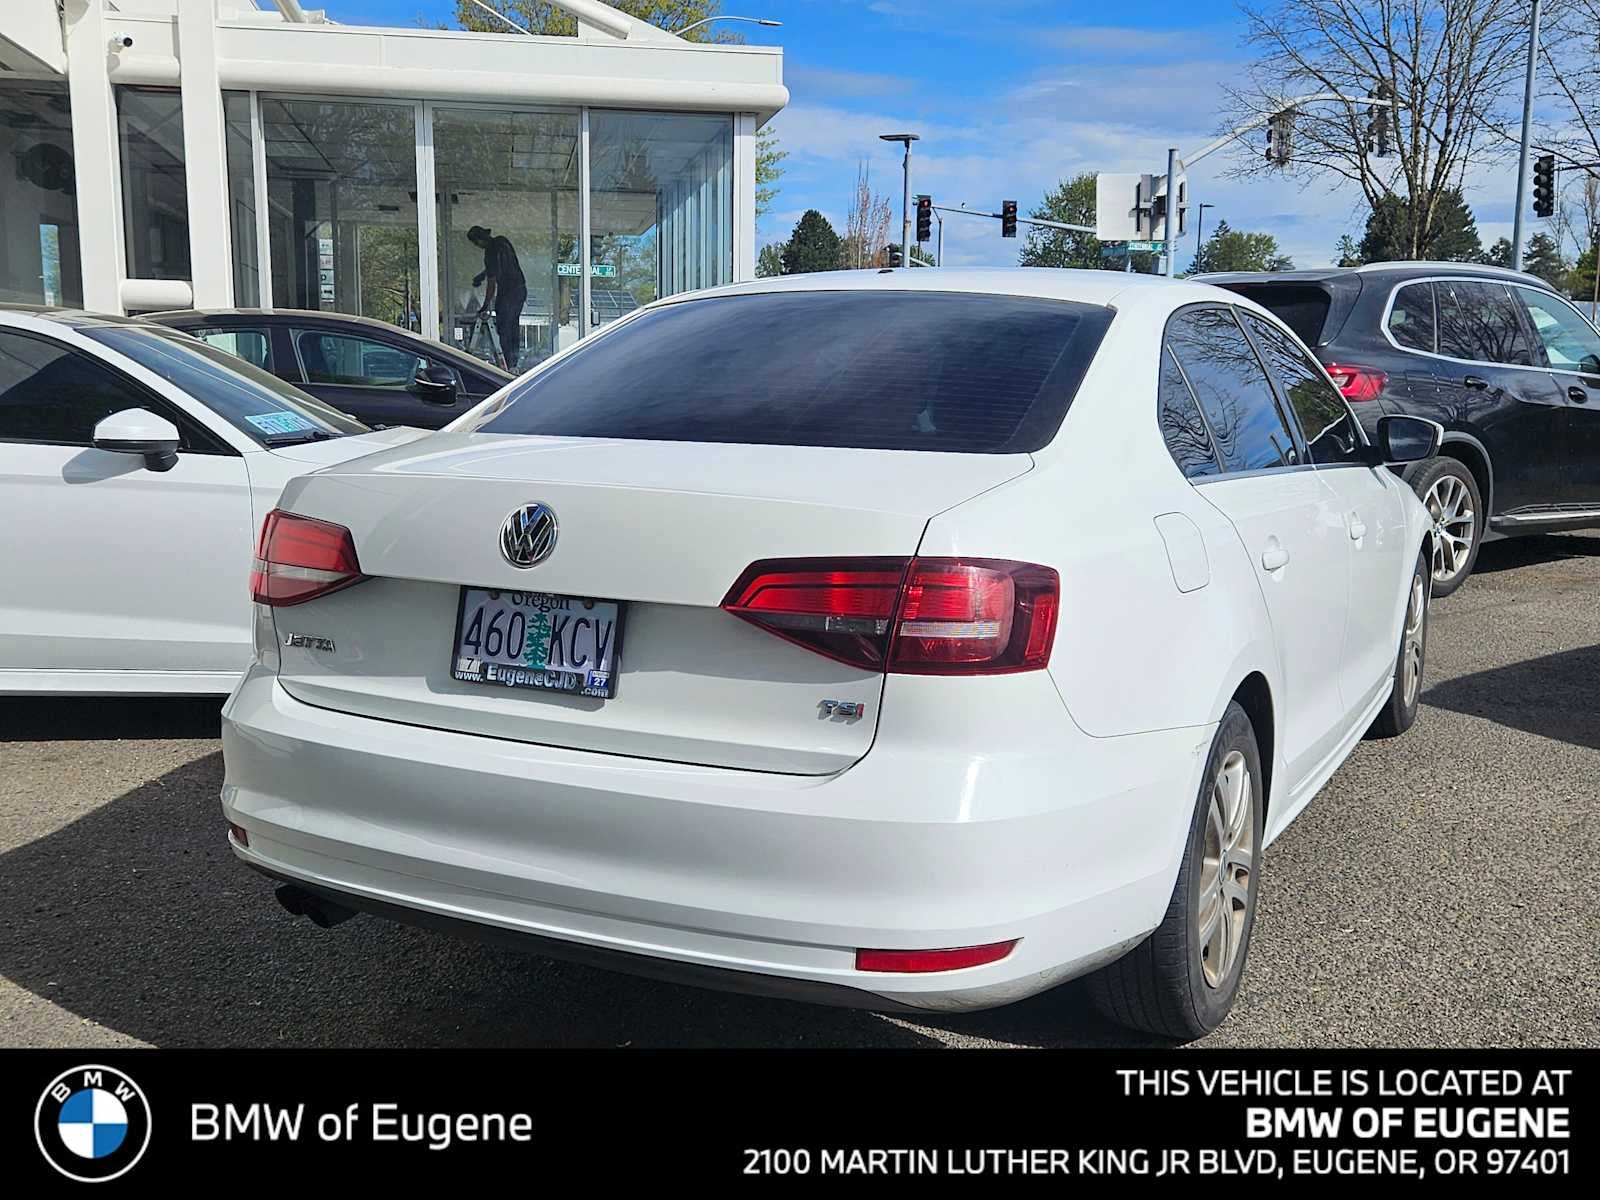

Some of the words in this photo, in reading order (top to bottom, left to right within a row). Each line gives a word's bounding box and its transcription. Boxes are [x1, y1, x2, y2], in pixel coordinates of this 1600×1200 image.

[557, 265, 601, 275] CENTEIAL
[511, 590, 571, 613] Oregon
[464, 607, 526, 660] 460
[547, 614, 614, 671] KCV
[465, 657, 476, 671] 7
[454, 672, 484, 682] www.
[593, 677, 606, 686] 27
[817, 699, 865, 720] TSI
